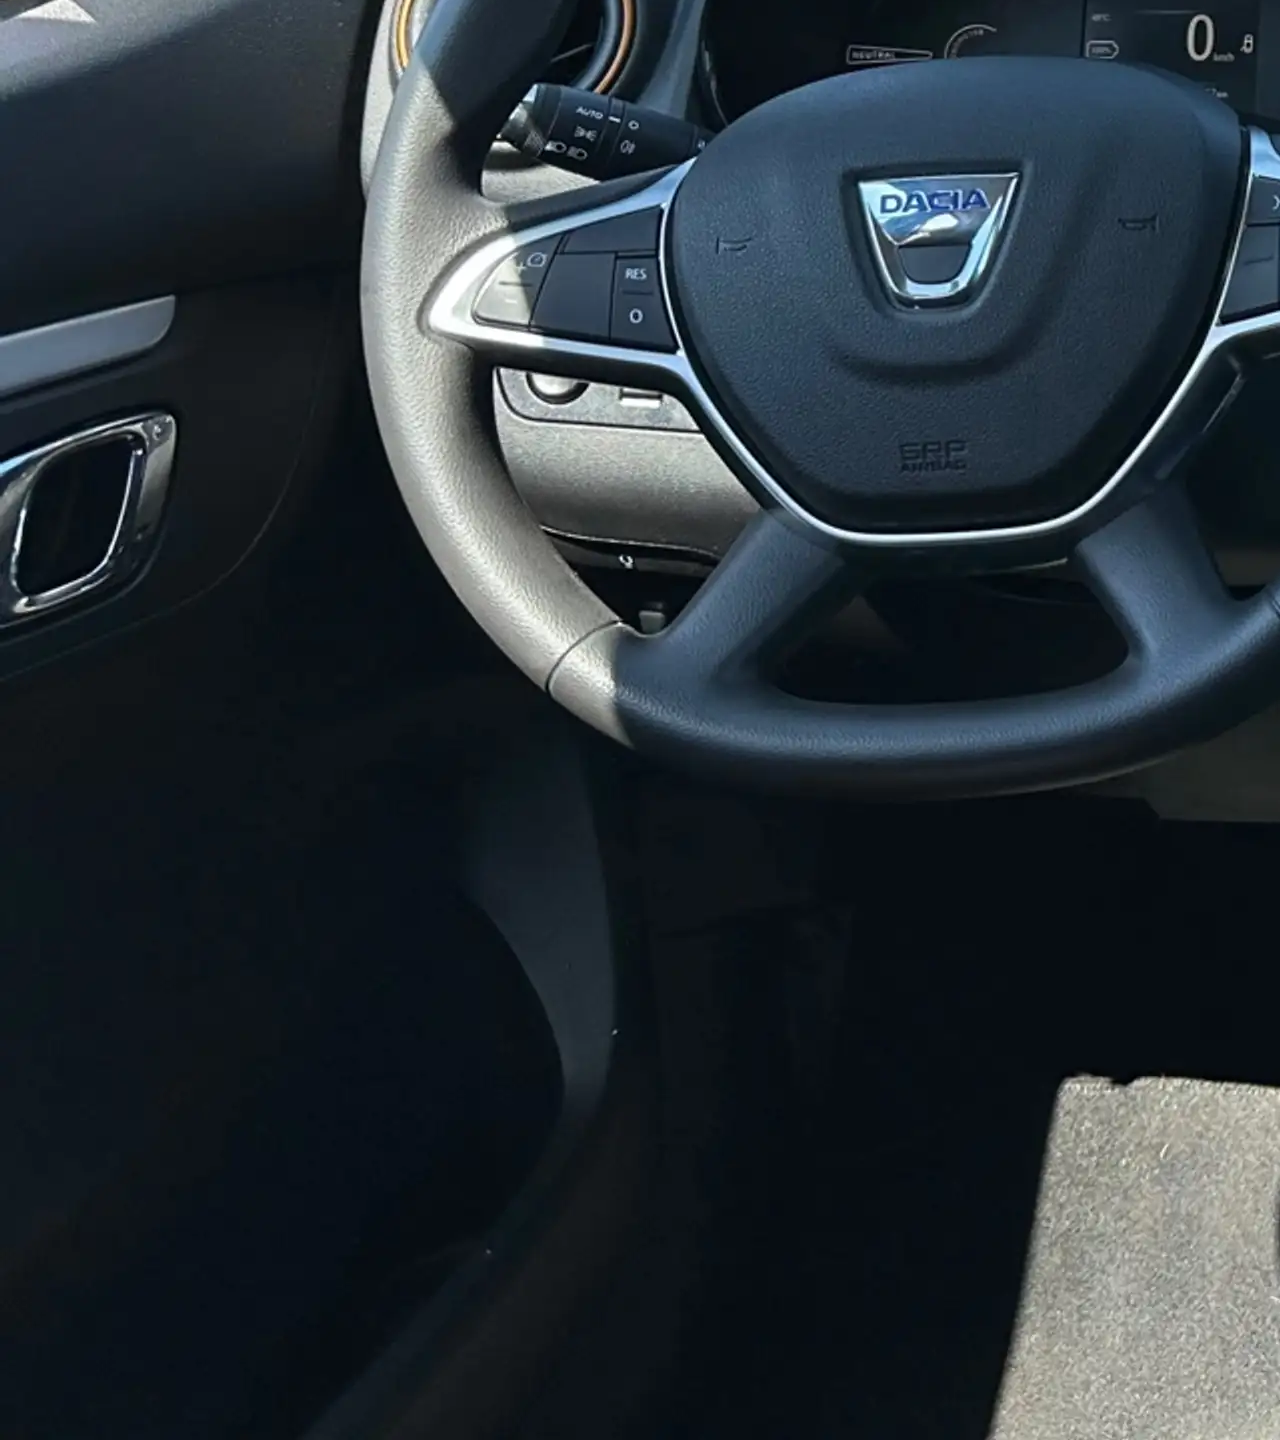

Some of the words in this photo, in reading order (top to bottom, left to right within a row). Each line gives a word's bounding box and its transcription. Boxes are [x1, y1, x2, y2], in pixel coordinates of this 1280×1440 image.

[1186, 13, 1215, 62] 0
[575, 105, 604, 121] AUTO
[880, 188, 991, 214] DACIA
[625, 267, 647, 280] RES
